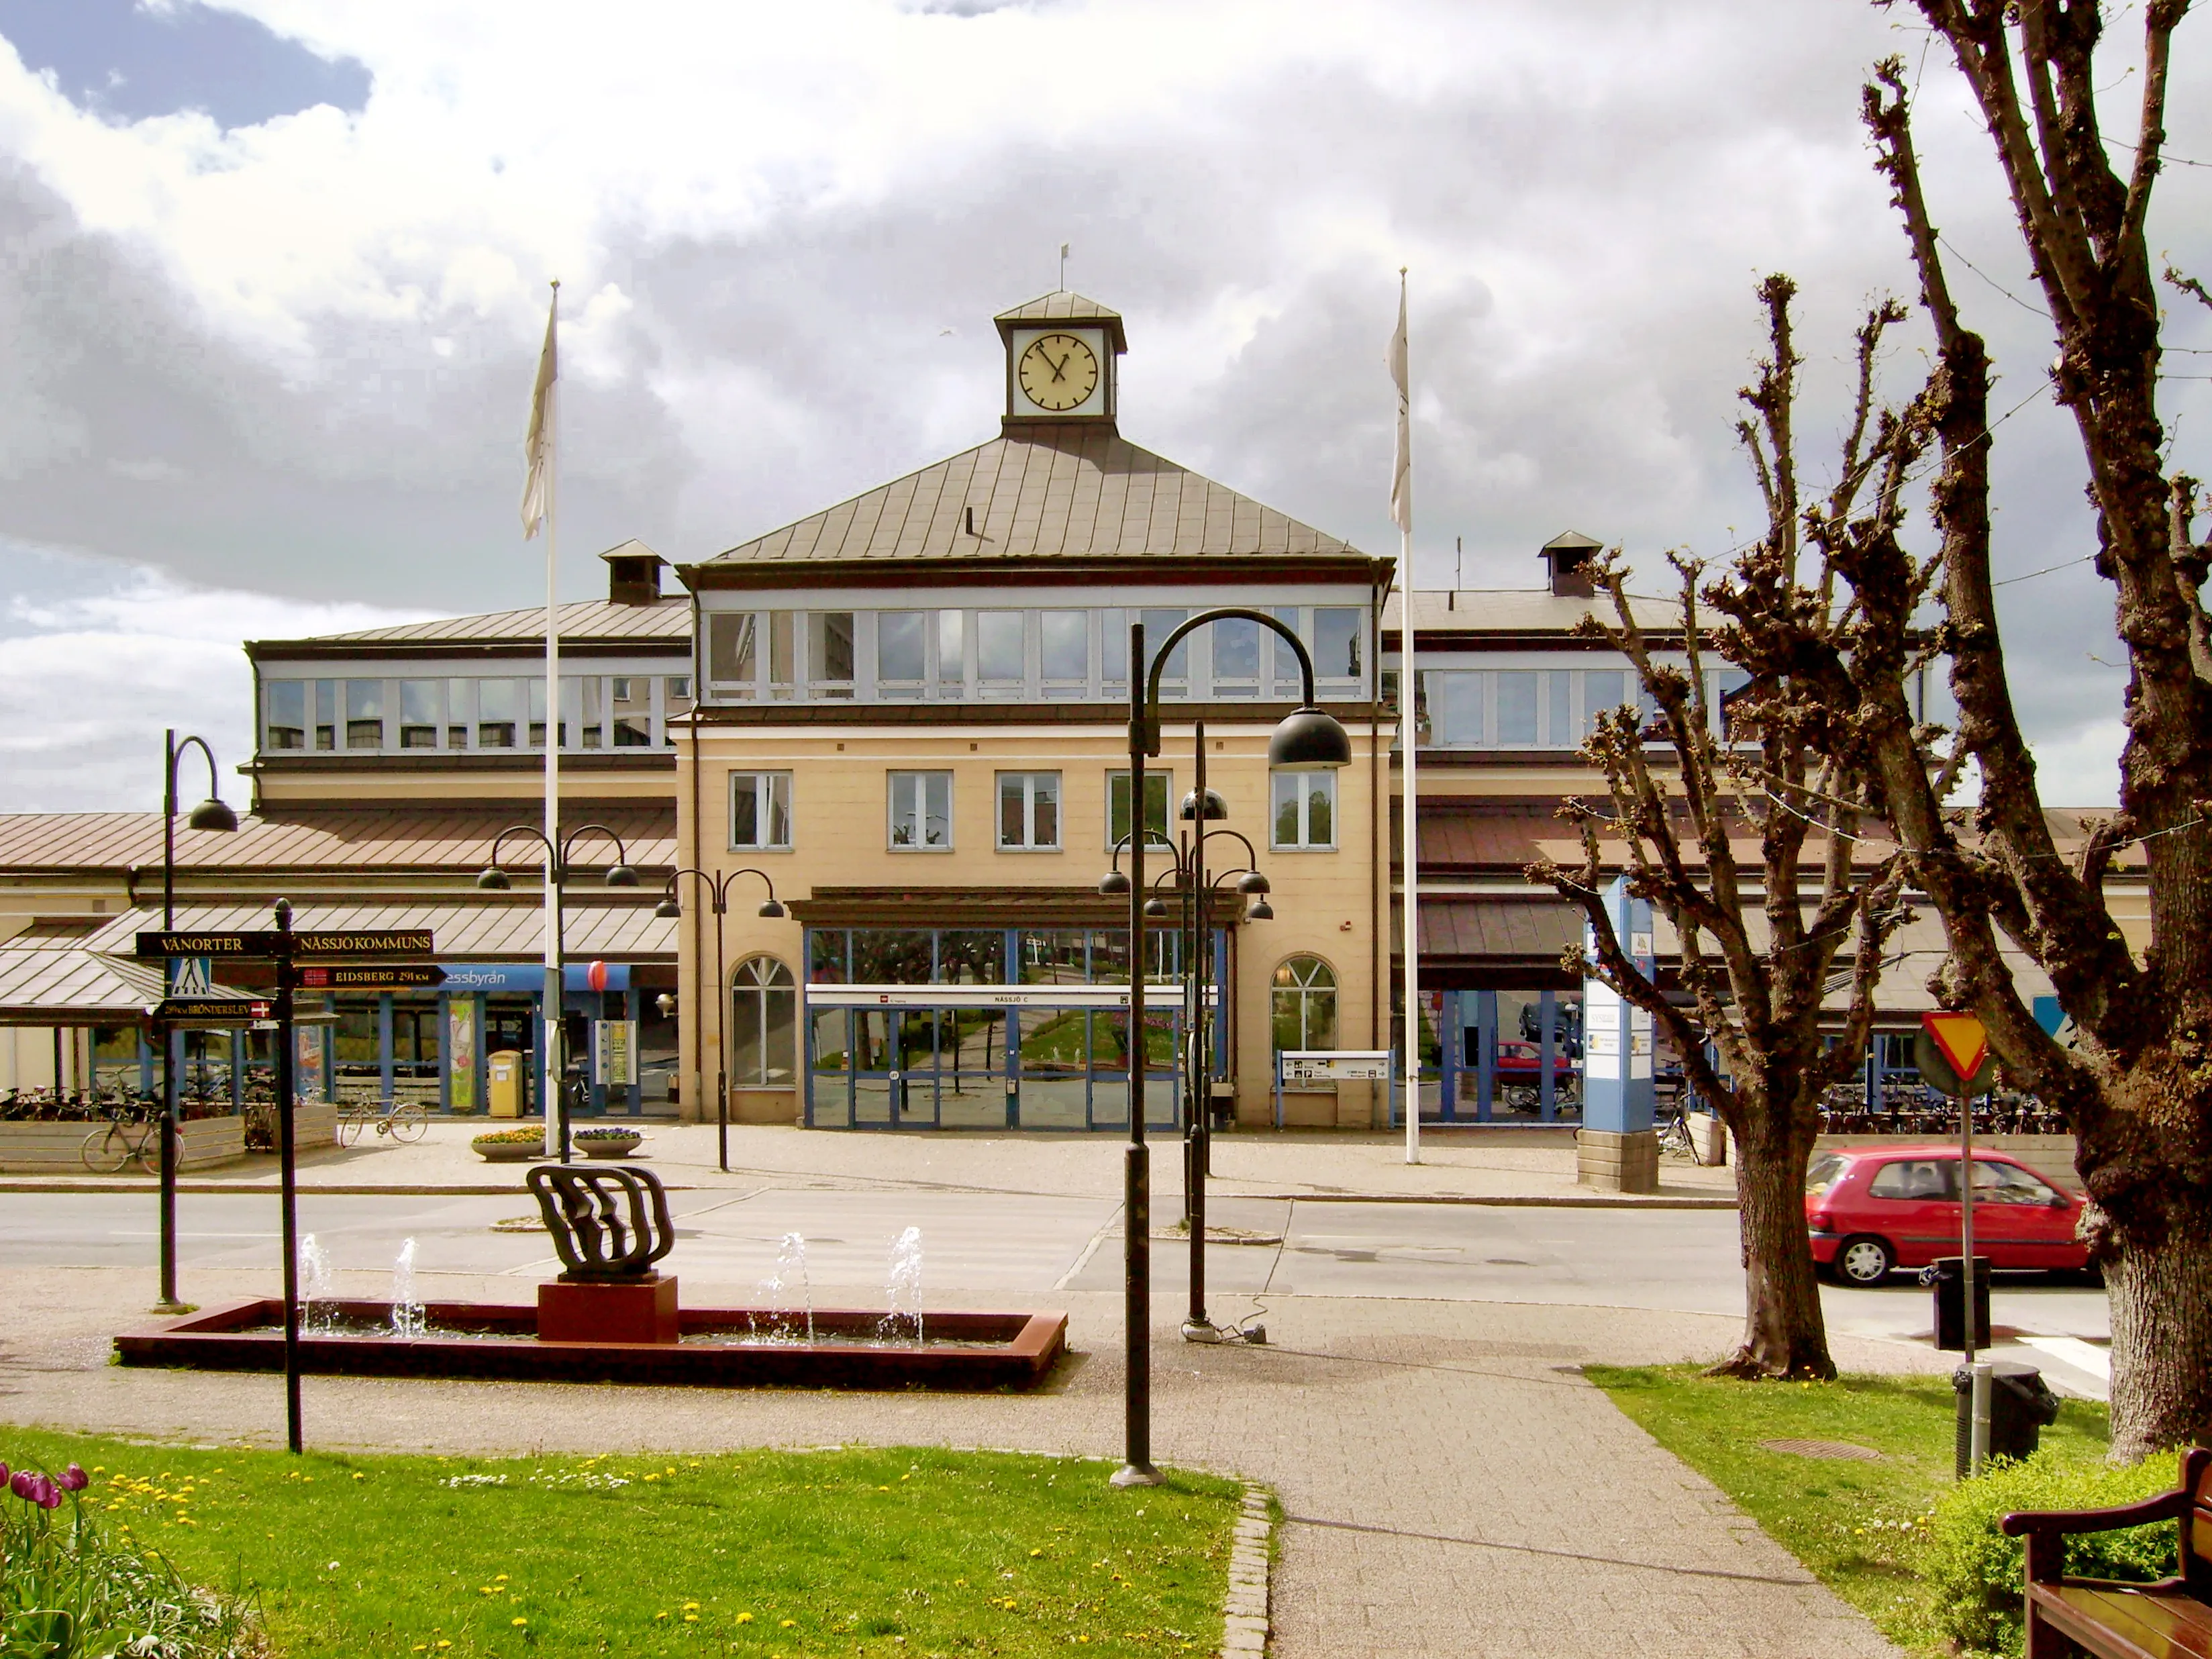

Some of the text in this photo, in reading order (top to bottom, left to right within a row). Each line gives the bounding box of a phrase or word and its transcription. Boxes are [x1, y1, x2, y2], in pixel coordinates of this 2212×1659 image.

[161, 936, 244, 951] VÄNORTER
[301, 936, 431, 950] NÄSSJÖ KOMMUNS
[336, 972, 394, 982] EIDSBERG
[399, 972, 414, 981] 291
[444, 970, 506, 987] essbyrån
